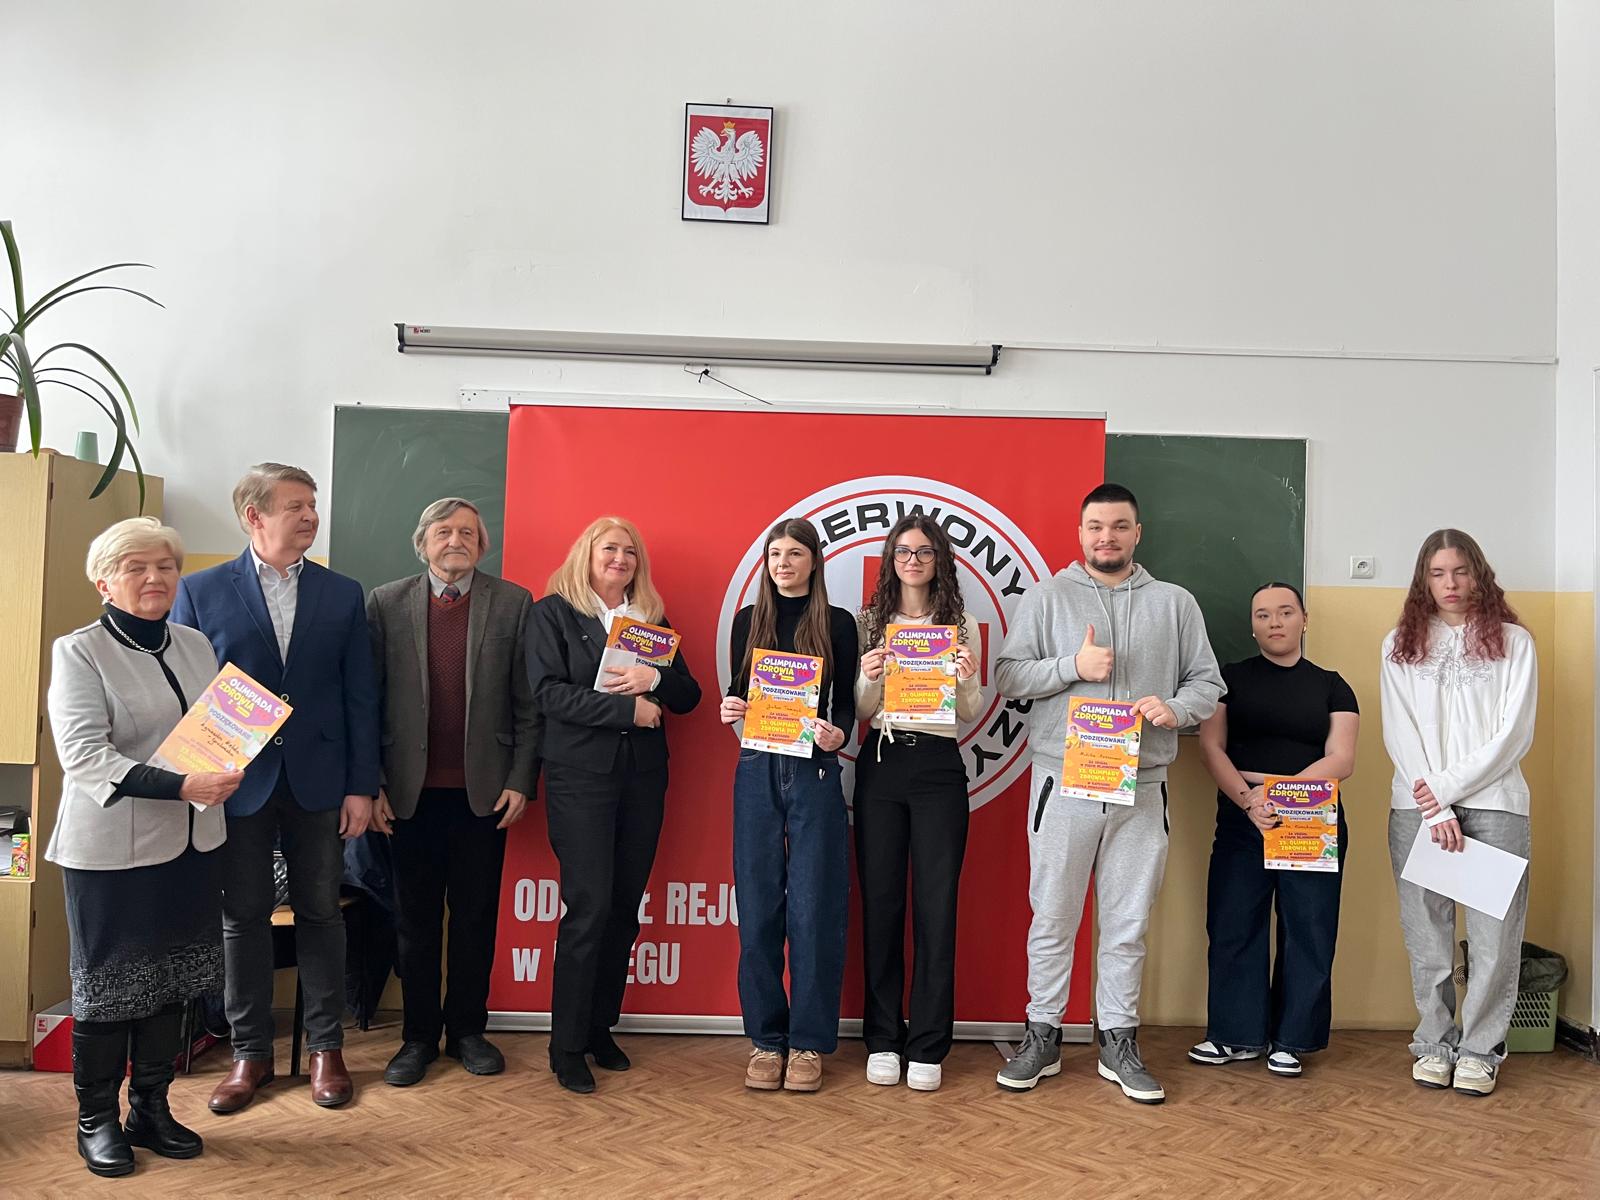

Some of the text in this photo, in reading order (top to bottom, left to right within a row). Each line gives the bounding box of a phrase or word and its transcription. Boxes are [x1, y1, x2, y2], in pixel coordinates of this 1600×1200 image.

[622, 631, 653, 647] ZDROWIA
[629, 627, 666, 644] OLIMPIADA
[764, 658, 808, 669] OLIMPIADA
[757, 664, 794, 675] ZDROWIA
[218, 681, 255, 712] ZDROWIA
[230, 678, 273, 713] OLIMPIADA
[763, 687, 806, 696] PODZIĘKOWANIE
[1074, 711, 1113, 722] ZDROWIA
[1081, 705, 1127, 717] OLIMPIADA
[1081, 734, 1126, 744] PODZIĘKOWANIE
